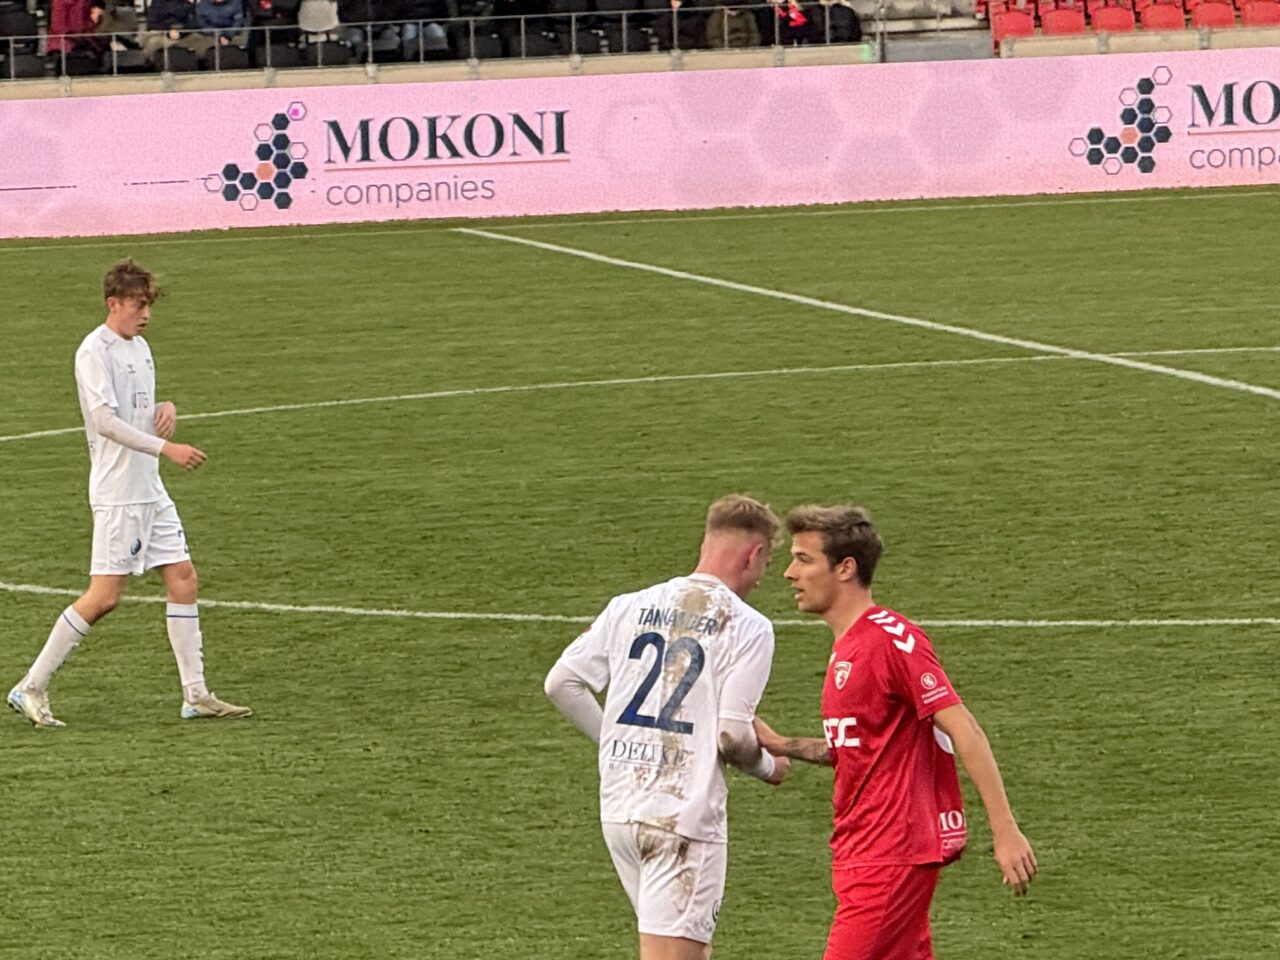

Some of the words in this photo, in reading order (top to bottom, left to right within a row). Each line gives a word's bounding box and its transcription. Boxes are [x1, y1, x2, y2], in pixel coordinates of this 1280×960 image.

[323, 110, 570, 164] MOKONI
[1189, 146, 1280, 173] comp
[326, 175, 496, 209] companies
[616, 632, 706, 736] 22
